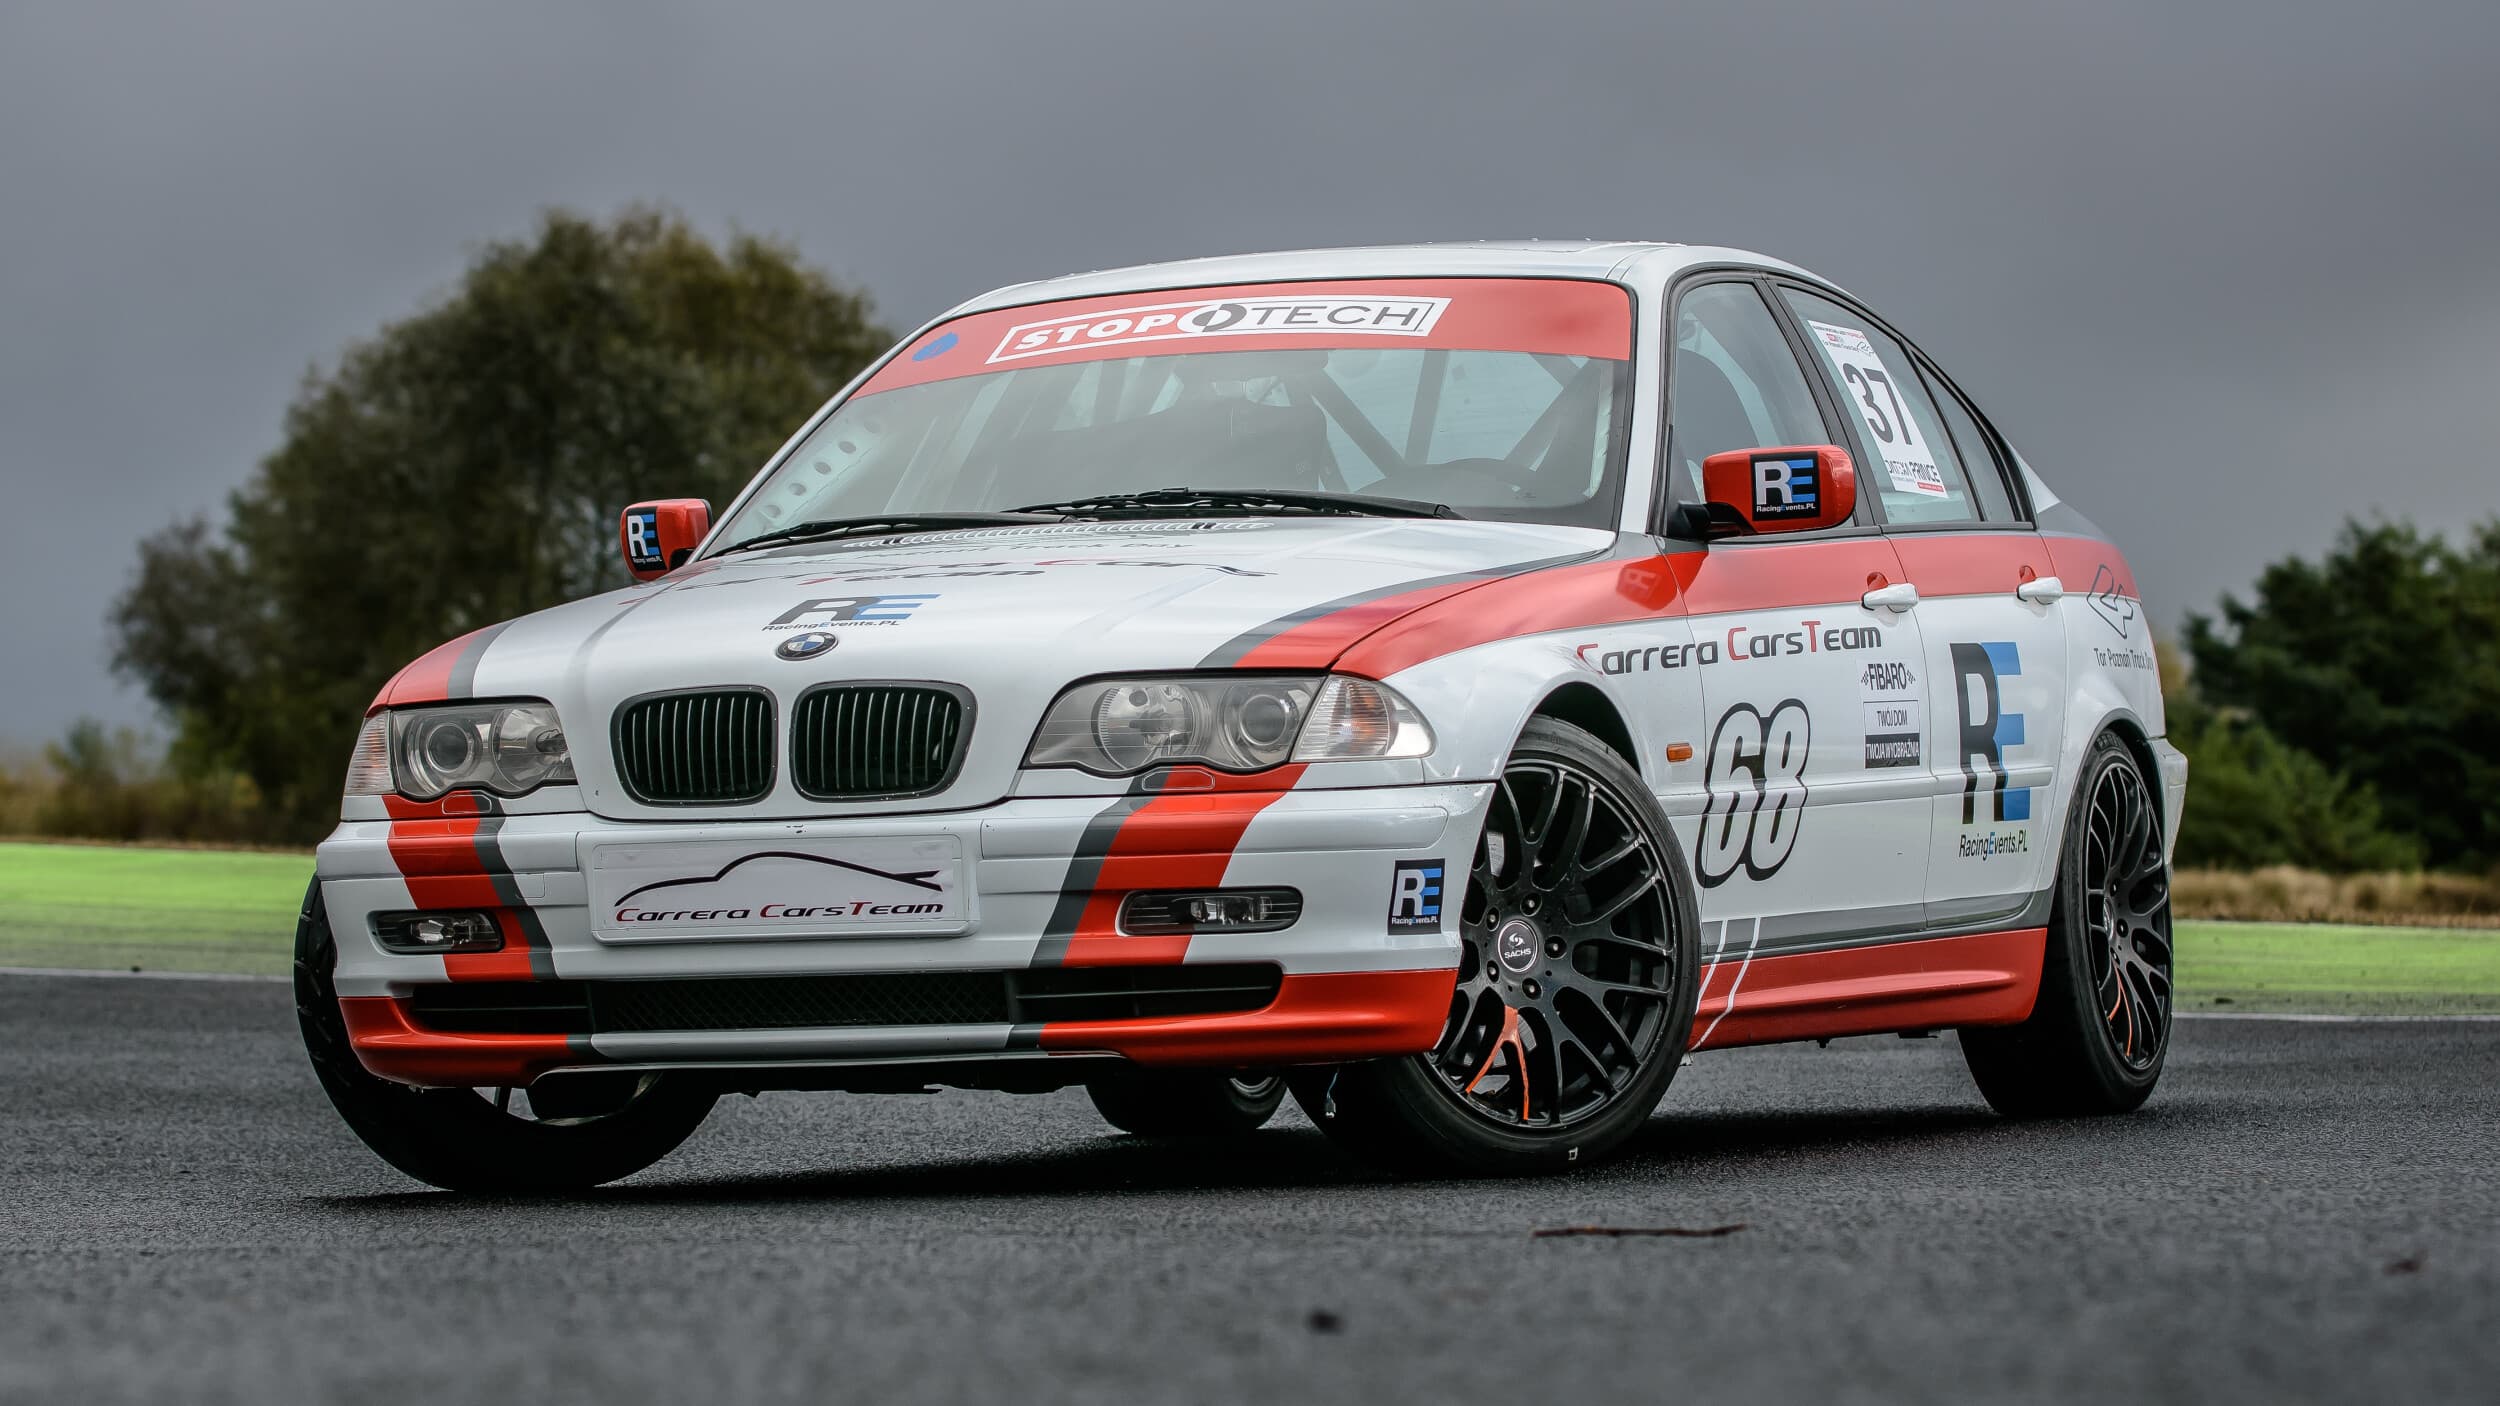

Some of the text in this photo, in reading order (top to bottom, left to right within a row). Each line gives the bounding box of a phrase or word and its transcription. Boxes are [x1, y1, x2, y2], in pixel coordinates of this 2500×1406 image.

[1013, 305, 1420, 350] STOP TECH
[1842, 362, 1913, 446] 37
[1755, 458, 1816, 505] RE
[1756, 502, 1817, 513] RacingEvents.PL
[627, 513, 661, 557] RE
[761, 620, 901, 632] RacingEvents.PL
[769, 594, 942, 626] RE
[1576, 640, 1720, 676] Carrera
[1867, 662, 1907, 690] FIBARO
[1893, 709, 1908, 726] DOM
[1949, 641, 2031, 825] RE
[1694, 697, 1811, 889] 68
[1958, 829, 2028, 861] RacingEvents.PL
[1392, 867, 1442, 917] RE
[615, 907, 750, 922] Carrera
[1503, 947, 1532, 959] SACHS
